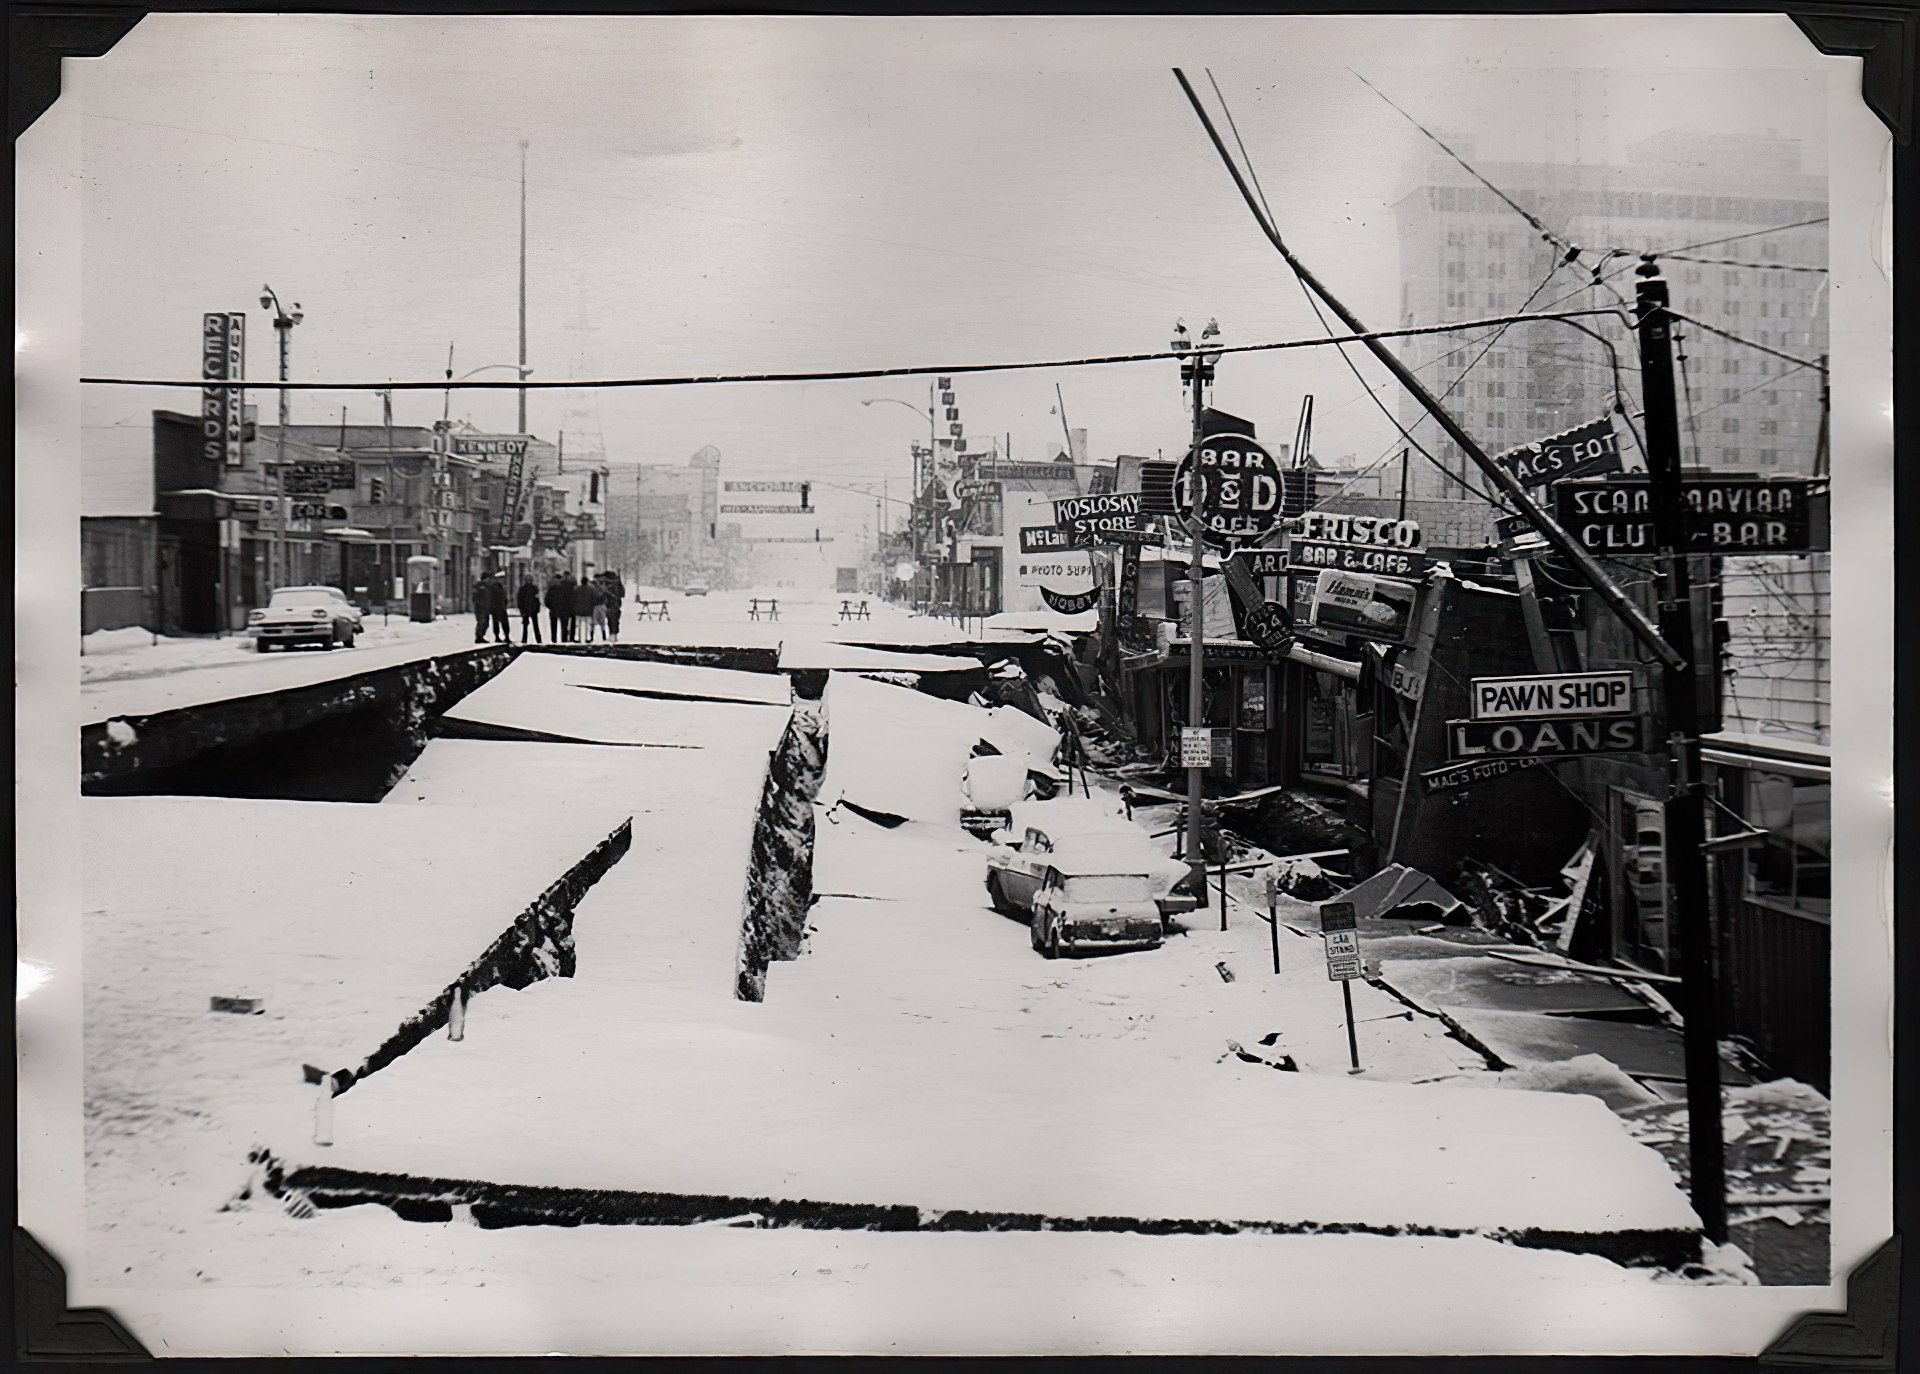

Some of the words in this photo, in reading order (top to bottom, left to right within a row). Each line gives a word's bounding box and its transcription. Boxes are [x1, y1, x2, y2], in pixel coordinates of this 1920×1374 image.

[203, 315, 222, 459] RECORDS
[457, 442, 526, 454] KENNEDY
[1201, 449, 1264, 468] BAR
[1057, 494, 1140, 523] KOSLOSKY
[1075, 516, 1136, 533] STORE
[1303, 514, 1420, 548] FRISCO
[1302, 546, 1337, 566] BAR
[1344, 550, 1359, 568] &
[1363, 552, 1409, 573] CAFE
[1481, 684, 1554, 713] PAWN
[1559, 680, 1626, 709] SHOP
[1457, 721, 1637, 755] LOANS
